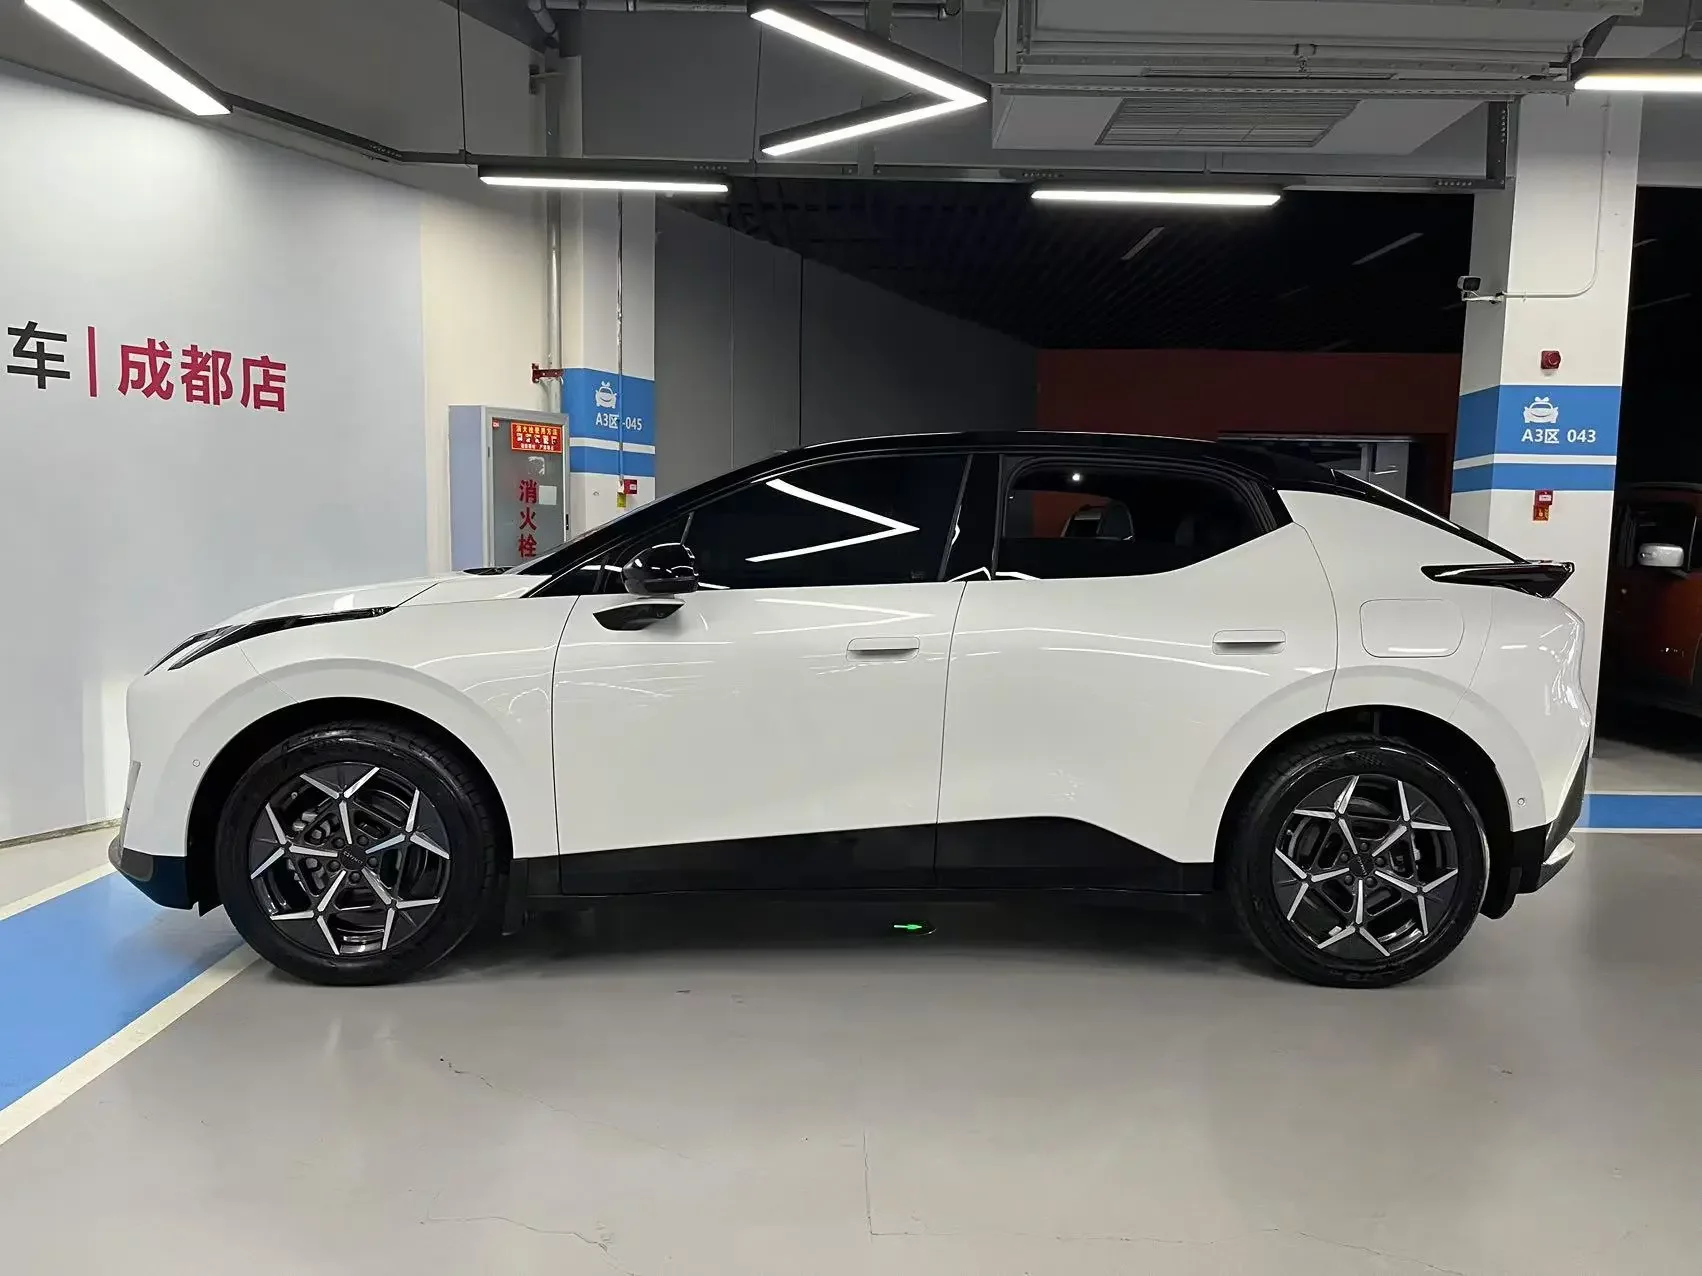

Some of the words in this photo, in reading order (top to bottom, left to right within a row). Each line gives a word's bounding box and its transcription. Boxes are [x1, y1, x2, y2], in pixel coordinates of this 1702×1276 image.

[7, 321, 71, 389] 车
[117, 337, 287, 412] 成都店
[1567, 429, 1596, 443] 043
[518, 479, 537, 558] 消火栓
